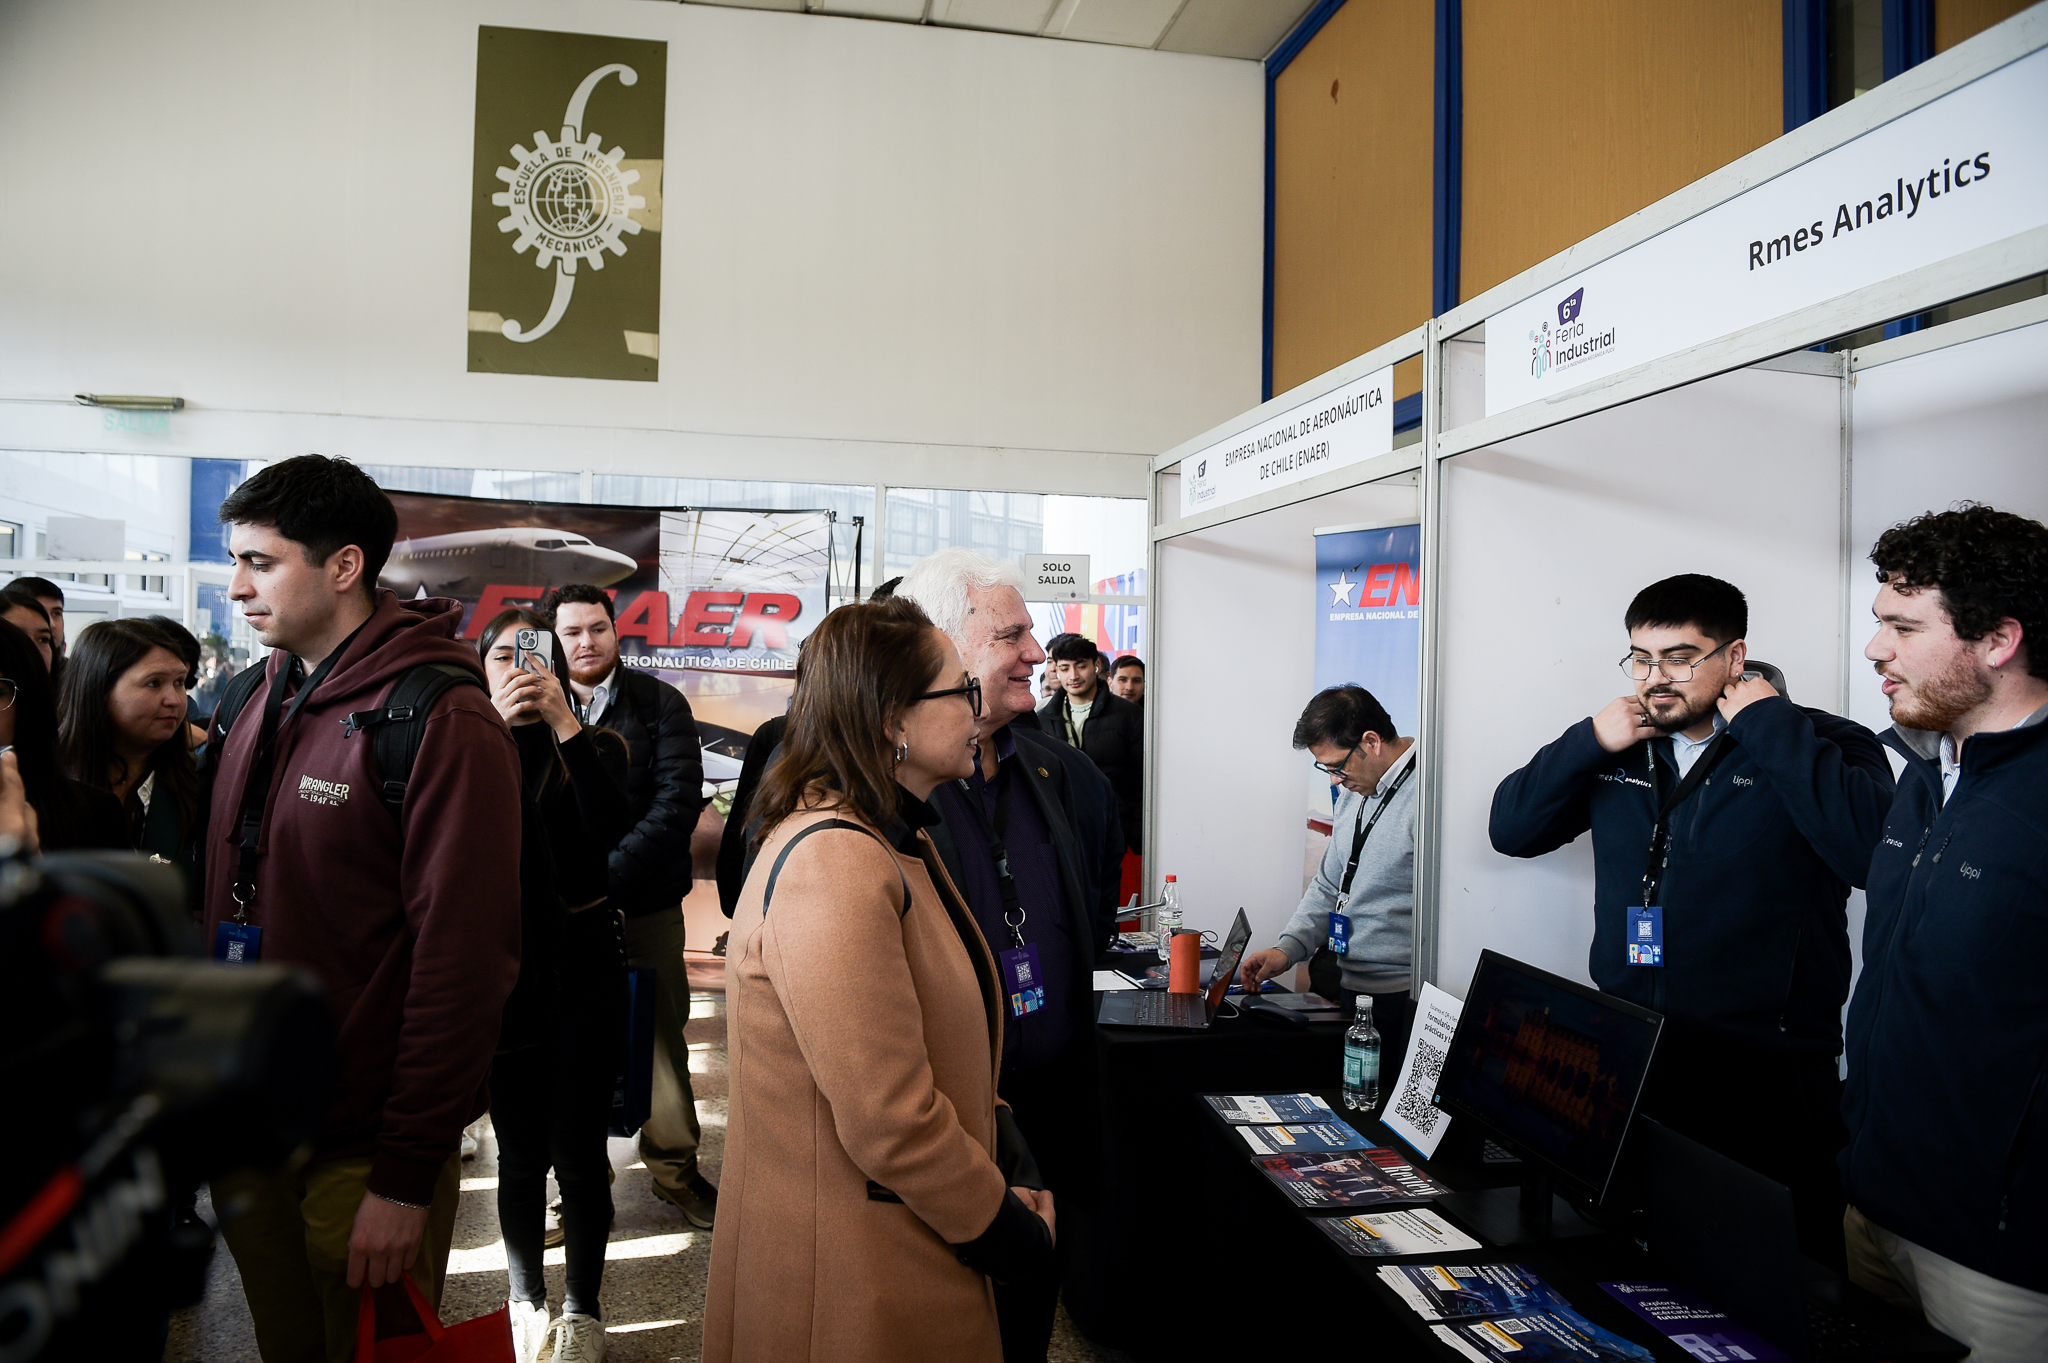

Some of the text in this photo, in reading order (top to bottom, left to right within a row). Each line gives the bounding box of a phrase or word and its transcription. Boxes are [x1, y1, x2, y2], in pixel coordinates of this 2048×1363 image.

[514, 146, 625, 215] ESCUELA DE INGENIERIA
[1749, 151, 1991, 271] Rmes Analytics
[535, 231, 604, 253] MECANICA
[1555, 323, 1584, 346] Feria
[1556, 327, 1615, 366] Industrial
[104, 412, 168, 432] SALIDA
[1225, 387, 1383, 467] EMPRESA NACIONAL DE AERONÁUTICA
[1260, 441, 1330, 480] DE CHILE (ENAER)
[1043, 563, 1071, 572] SOLO
[1038, 576, 1076, 585] SALIDA
[1359, 562, 1419, 607] EN
[464, 584, 802, 649] EAER
[1329, 610, 1418, 621] EMPRESA NACIONAL DE
[727, 657, 746, 669] DE
[750, 658, 794, 671] CHILE
[298, 774, 350, 800] WRANGLER
[310, 794, 328, 805] 1947
[1424, 1023, 1444, 1040] prácticas
[1427, 1011, 1450, 1031] Formulario
